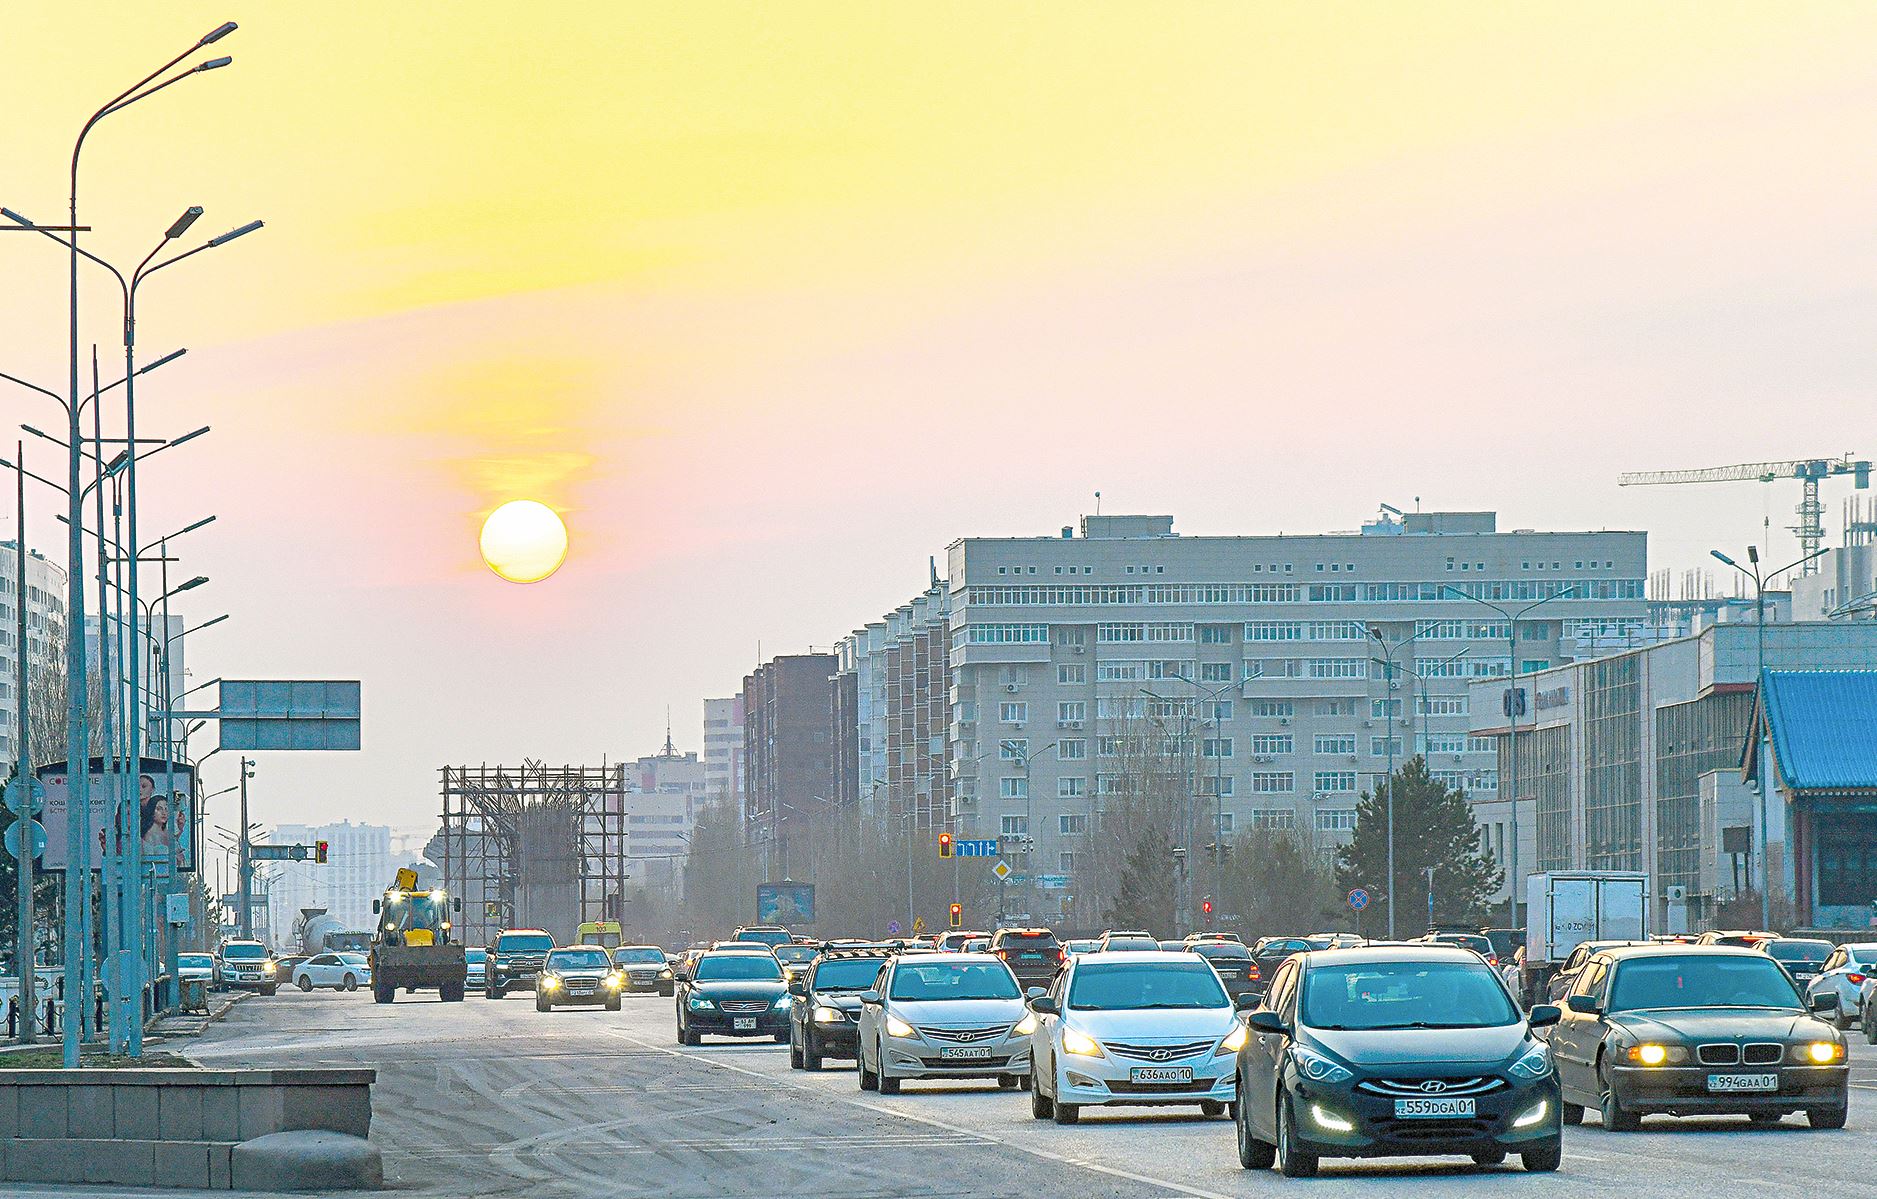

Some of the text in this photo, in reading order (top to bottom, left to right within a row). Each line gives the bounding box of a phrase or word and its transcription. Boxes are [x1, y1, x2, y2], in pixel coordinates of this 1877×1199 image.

[1179, 1069, 1191, 1080] 10
[1718, 1076, 1760, 1088] 994GAA
[1762, 1076, 1777, 1088] 01
[1406, 1100, 1456, 1114] 559DGA
[1458, 1099, 1474, 1114] 01
